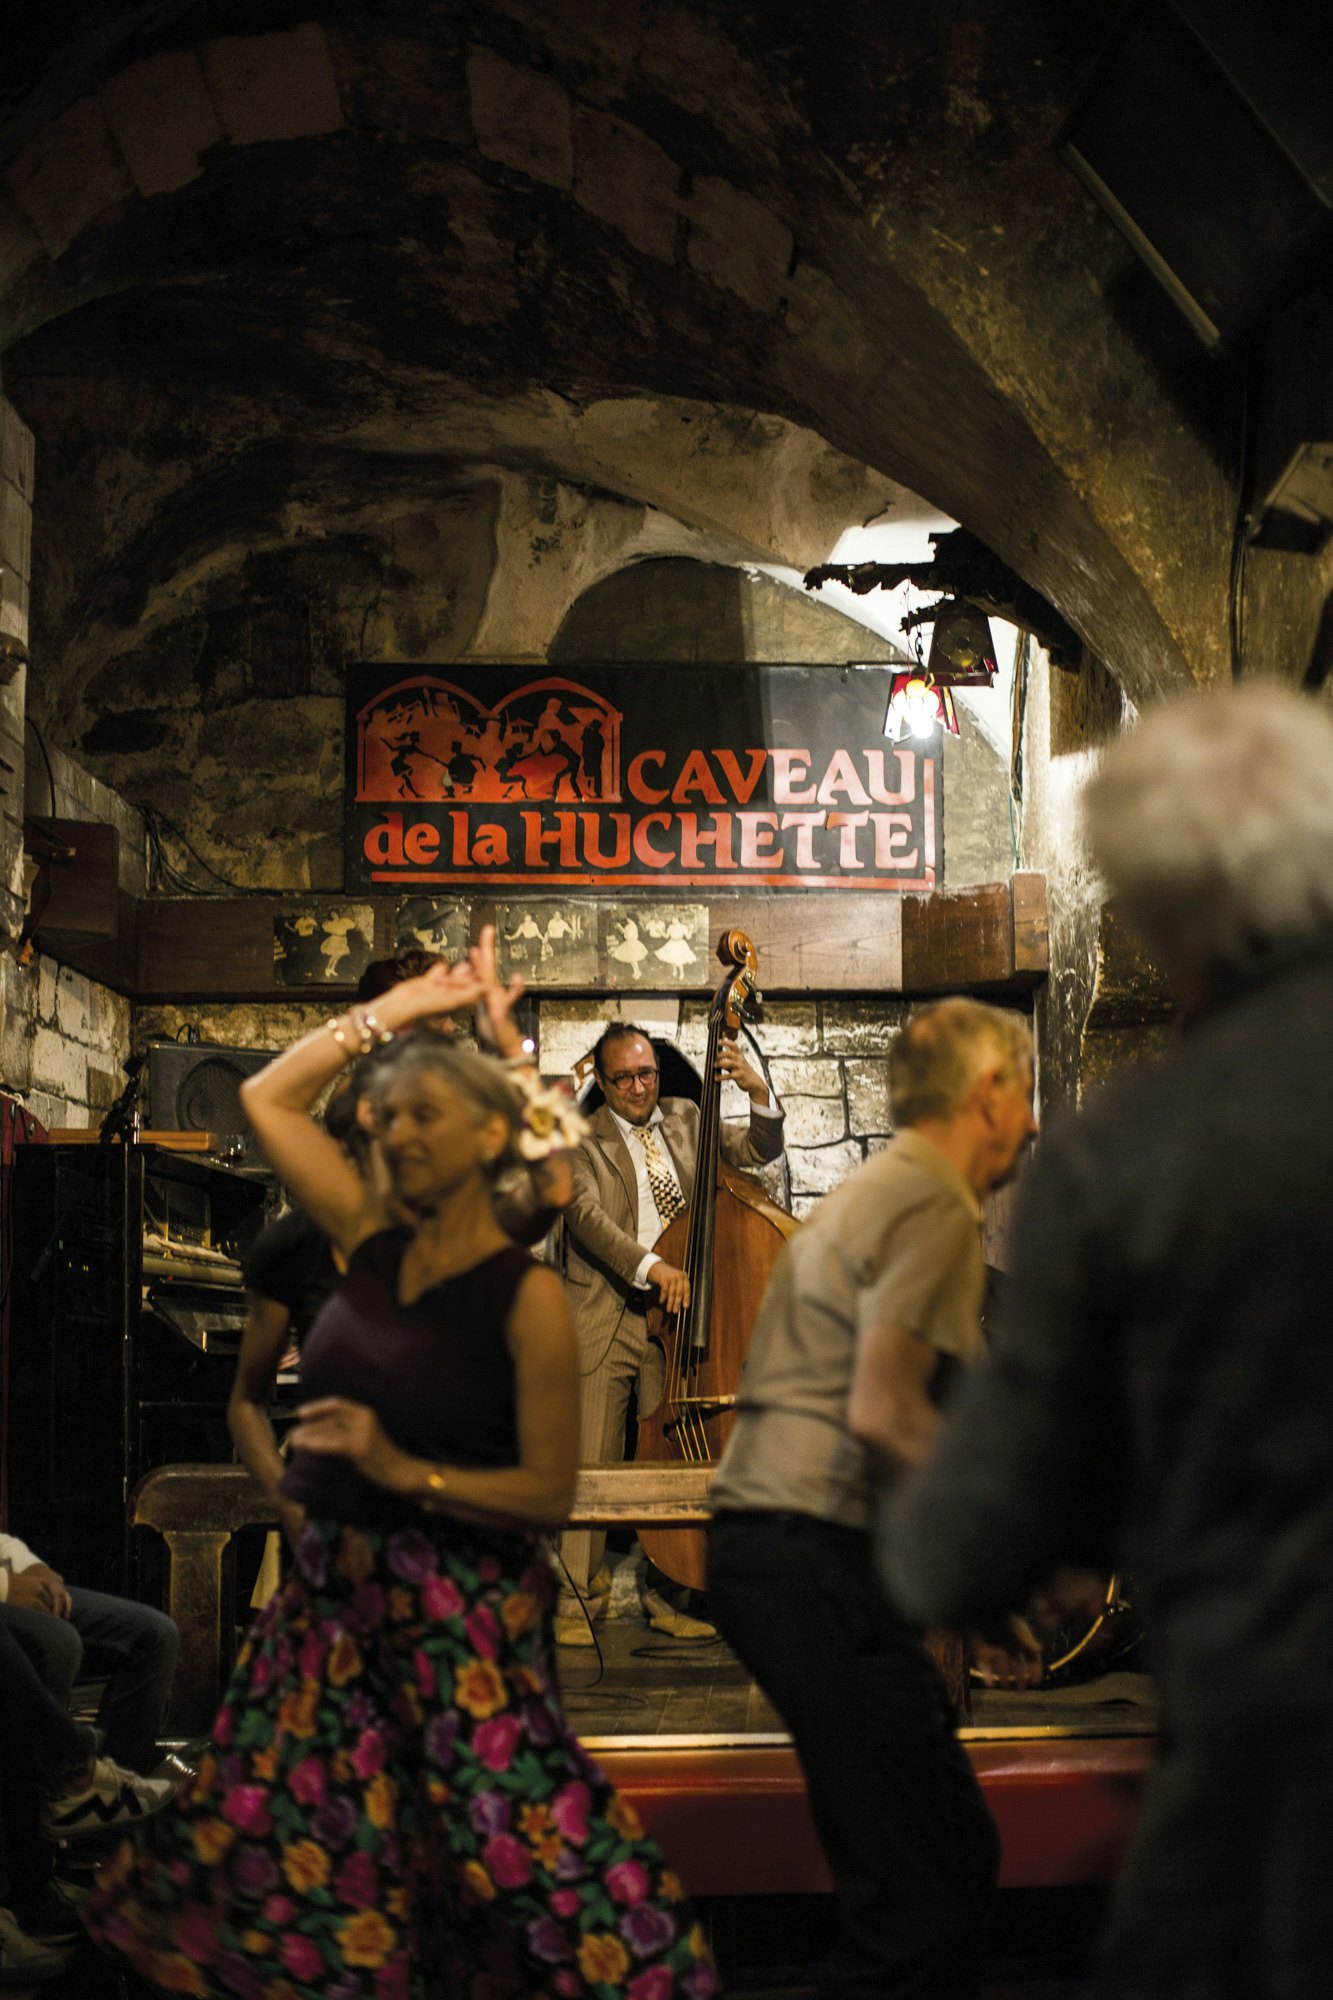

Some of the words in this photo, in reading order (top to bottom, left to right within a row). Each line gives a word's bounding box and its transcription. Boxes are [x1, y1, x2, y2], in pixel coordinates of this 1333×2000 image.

[626, 749, 915, 805] CAVEAU
[364, 812, 440, 866] de
[449, 811, 510, 866] la
[521, 810, 918, 869] HUCHETTE
